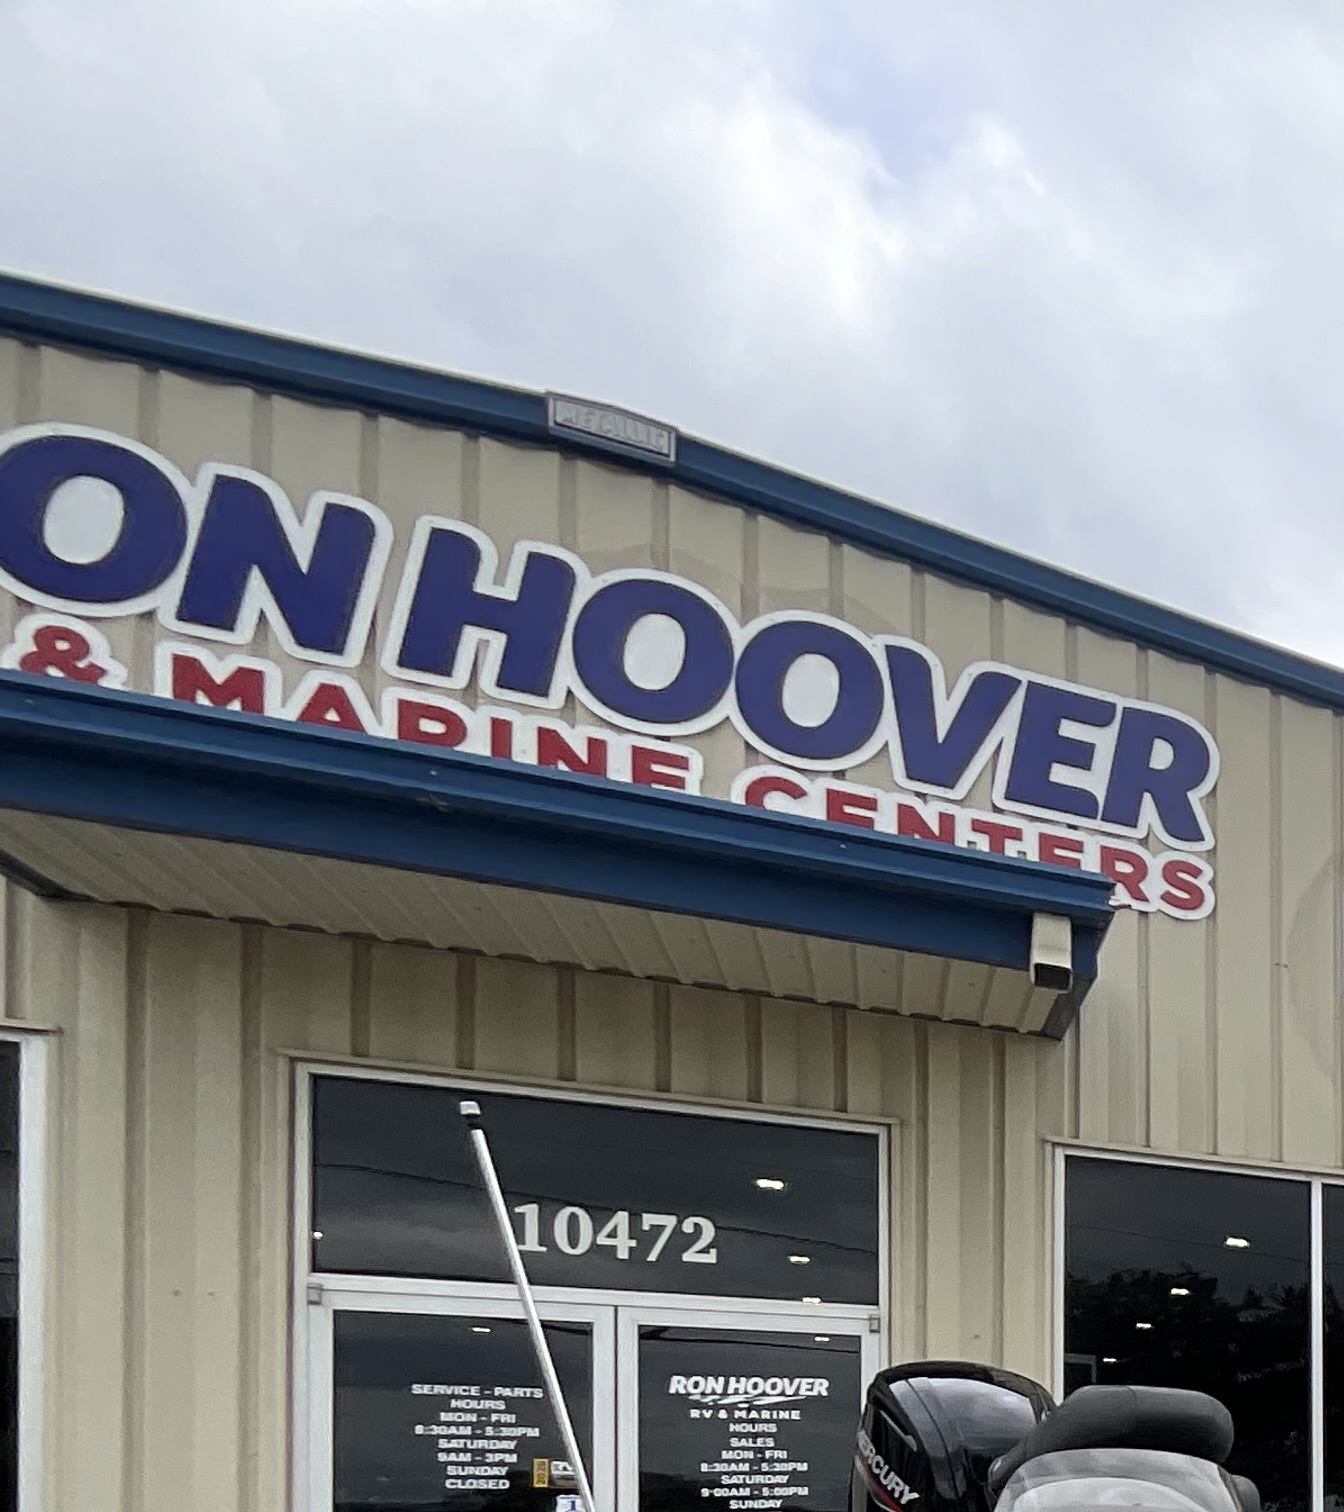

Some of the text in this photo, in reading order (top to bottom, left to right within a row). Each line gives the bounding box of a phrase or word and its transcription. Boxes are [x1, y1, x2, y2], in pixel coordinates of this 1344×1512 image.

[18, 624, 106, 684] &
[394, 525, 1211, 844] HOOVER
[514, 1202, 718, 1264] 10472
[411, 1383, 481, 1396] SERVICE
[494, 1386, 544, 1398] PARTS
[669, 1375, 829, 1397] RON HOOVER
[450, 1399, 506, 1410] HOURS
[440, 1412, 477, 1422] MON
[491, 1413, 516, 1423] FRI
[690, 1409, 802, 1420] RV & MARINE
[729, 1422, 777, 1433] HOURS
[438, 1438, 518, 1450] SATURDAY
[729, 1437, 775, 1447] SALES
[485, 1453, 517, 1463] 3PM
[721, 1450, 754, 1460] MON
[765, 1450, 788, 1459] FRI
[447, 1466, 509, 1476] SUNDAY
[445, 1478, 510, 1489] CLOSED
[721, 1474, 790, 1485] SATURDAY
[729, 1499, 783, 1509] SUNDAY
